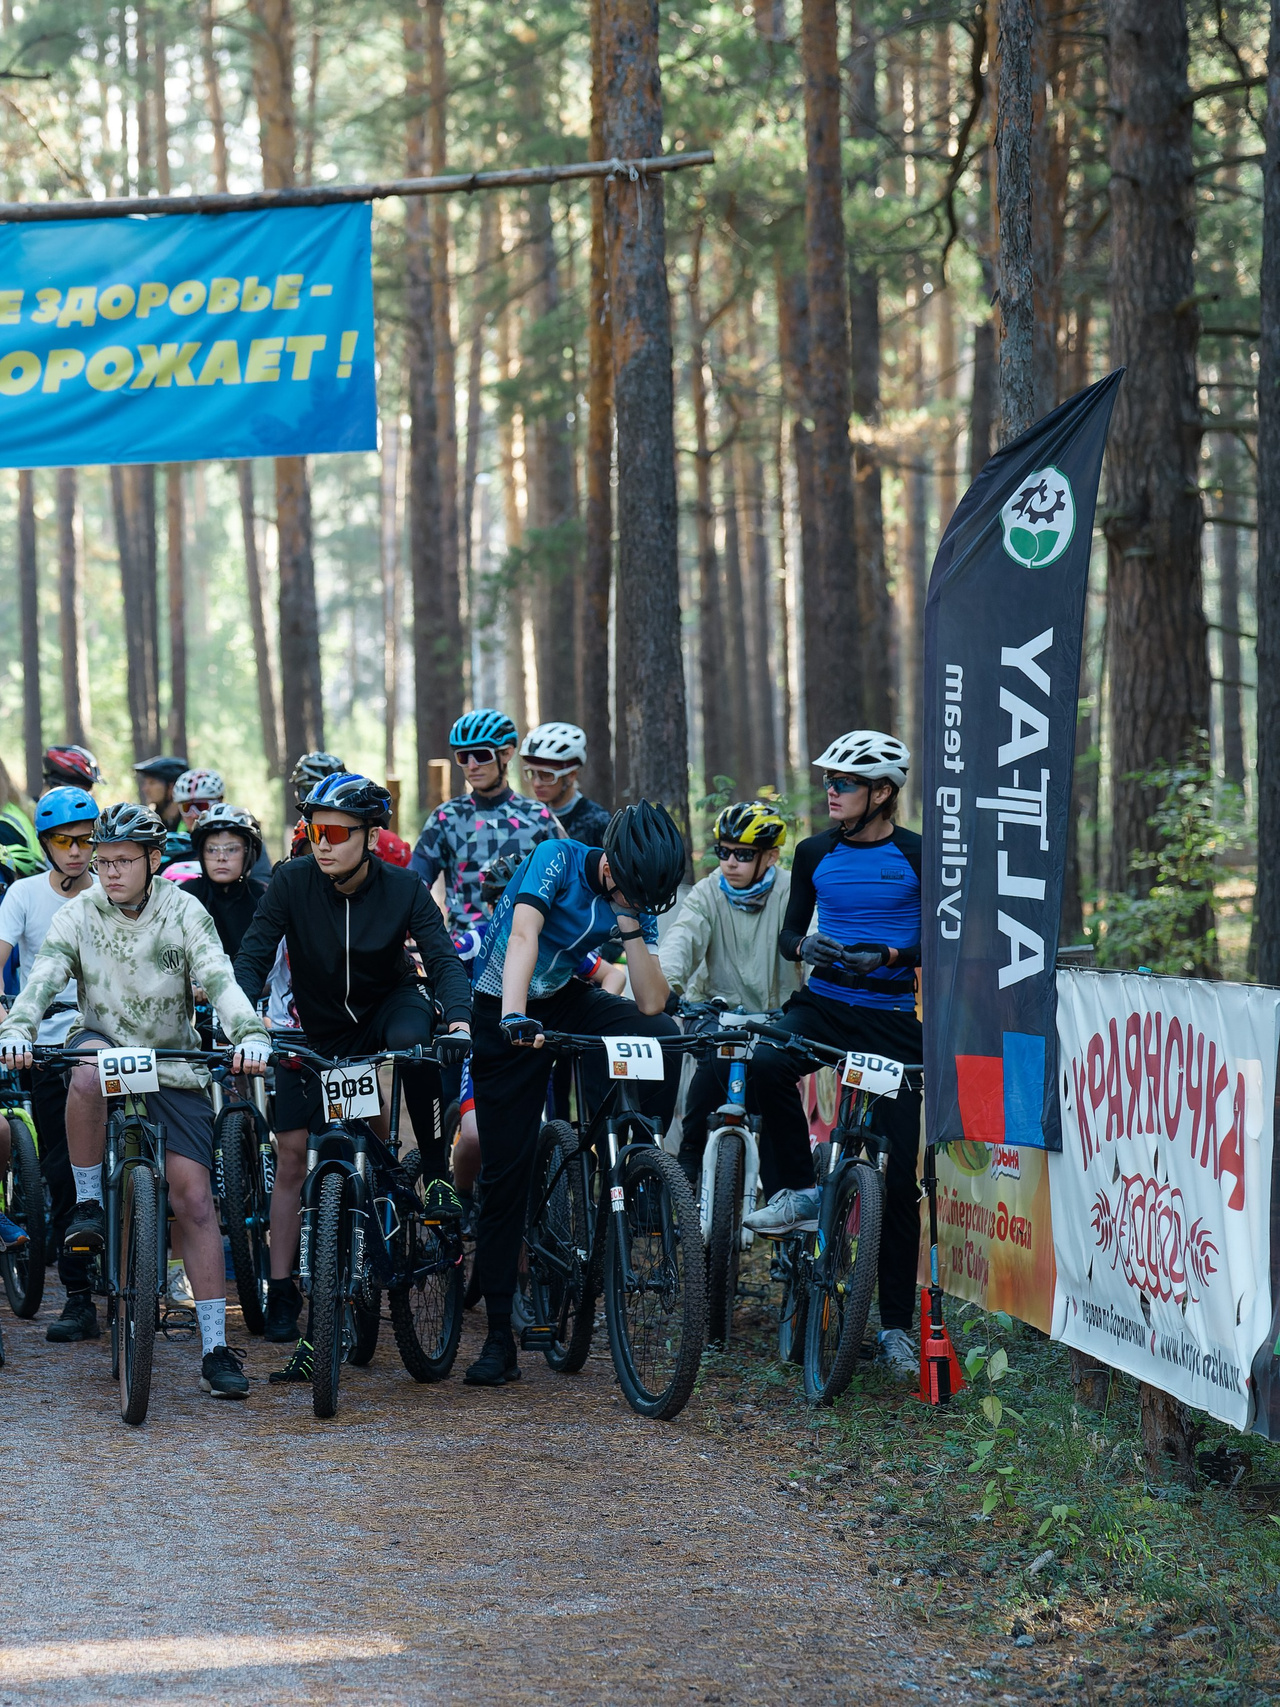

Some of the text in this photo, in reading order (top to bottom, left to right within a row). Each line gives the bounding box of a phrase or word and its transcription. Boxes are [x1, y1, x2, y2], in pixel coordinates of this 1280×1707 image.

[616, 1042, 653, 1059] 911
[102, 1054, 153, 1077] 903
[851, 1052, 900, 1077] 904
[326, 1076, 375, 1101] 908
[1072, 1011, 1246, 1212] КРАЯНОЧКА
